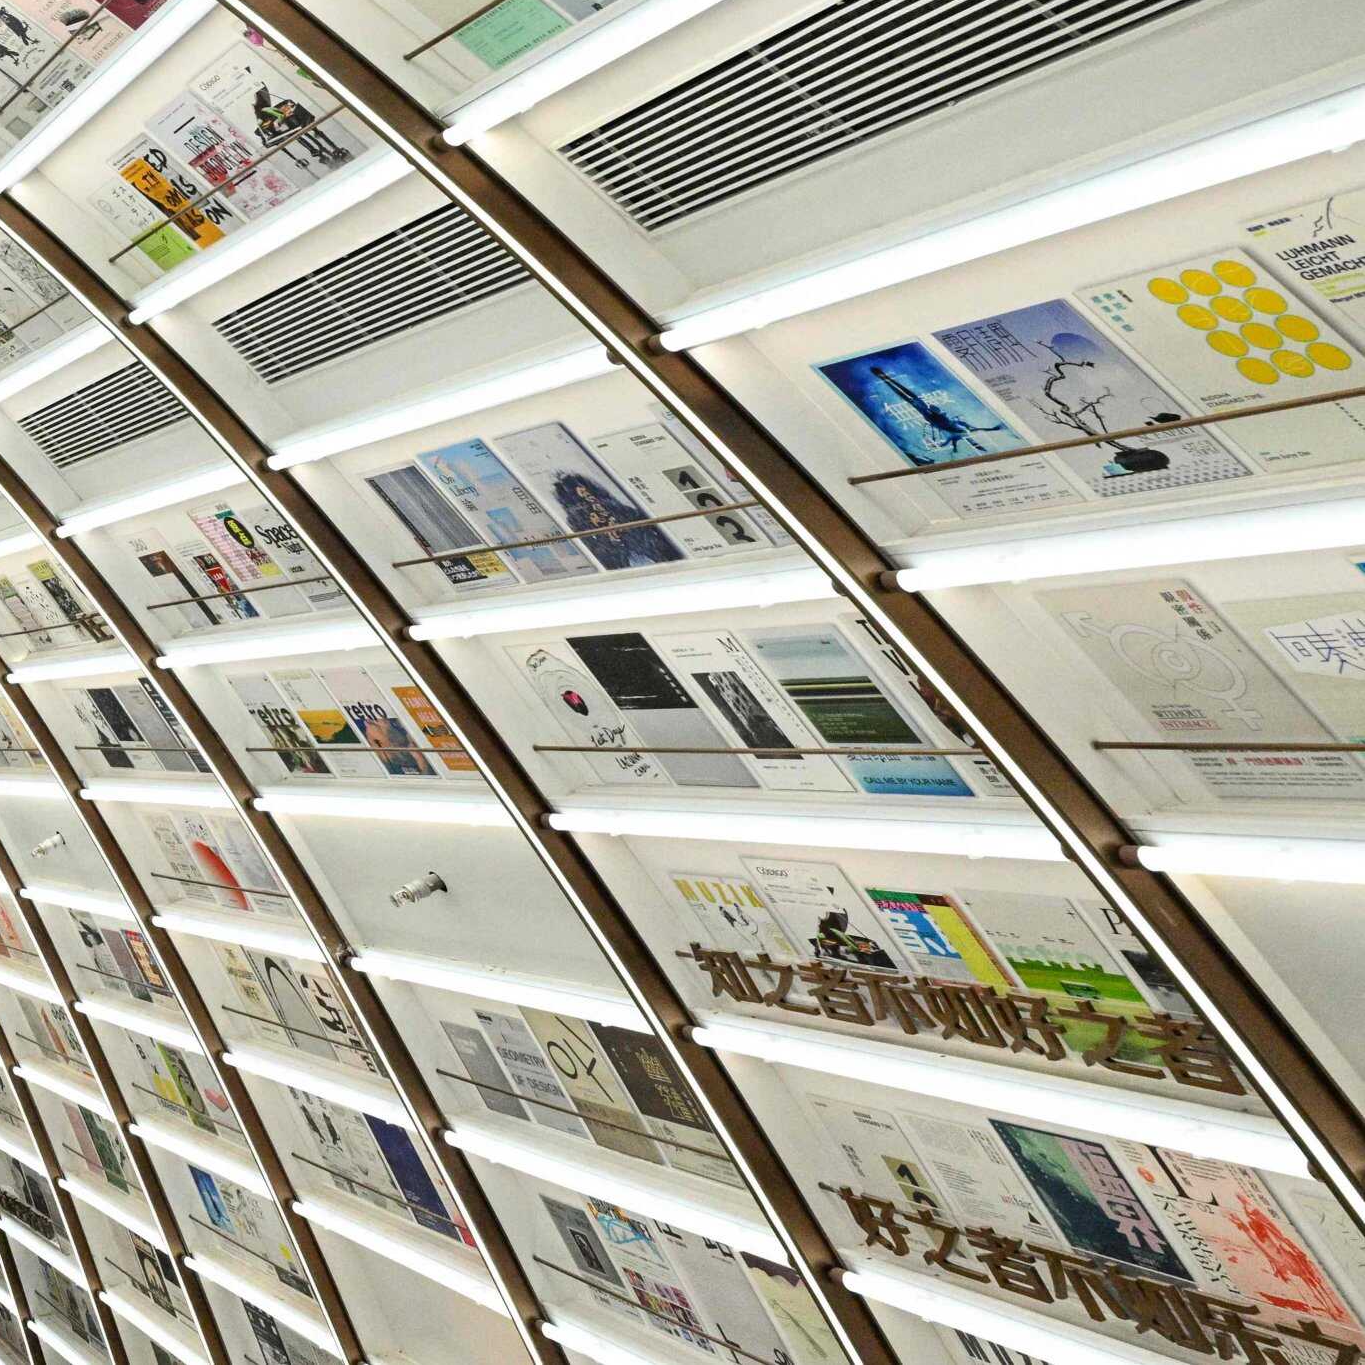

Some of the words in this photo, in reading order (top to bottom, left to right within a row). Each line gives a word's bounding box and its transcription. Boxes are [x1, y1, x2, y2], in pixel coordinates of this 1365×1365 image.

[1275, 235, 1356, 261] LUHMANN
[1287, 251, 1340, 271] LEICHT
[255, 521, 296, 547] Space
[248, 707, 296, 726] retro
[345, 701, 387, 720] retro
[673, 878, 765, 909] MUZIK
[692, 943, 1252, 1096] 知之者不如好之者
